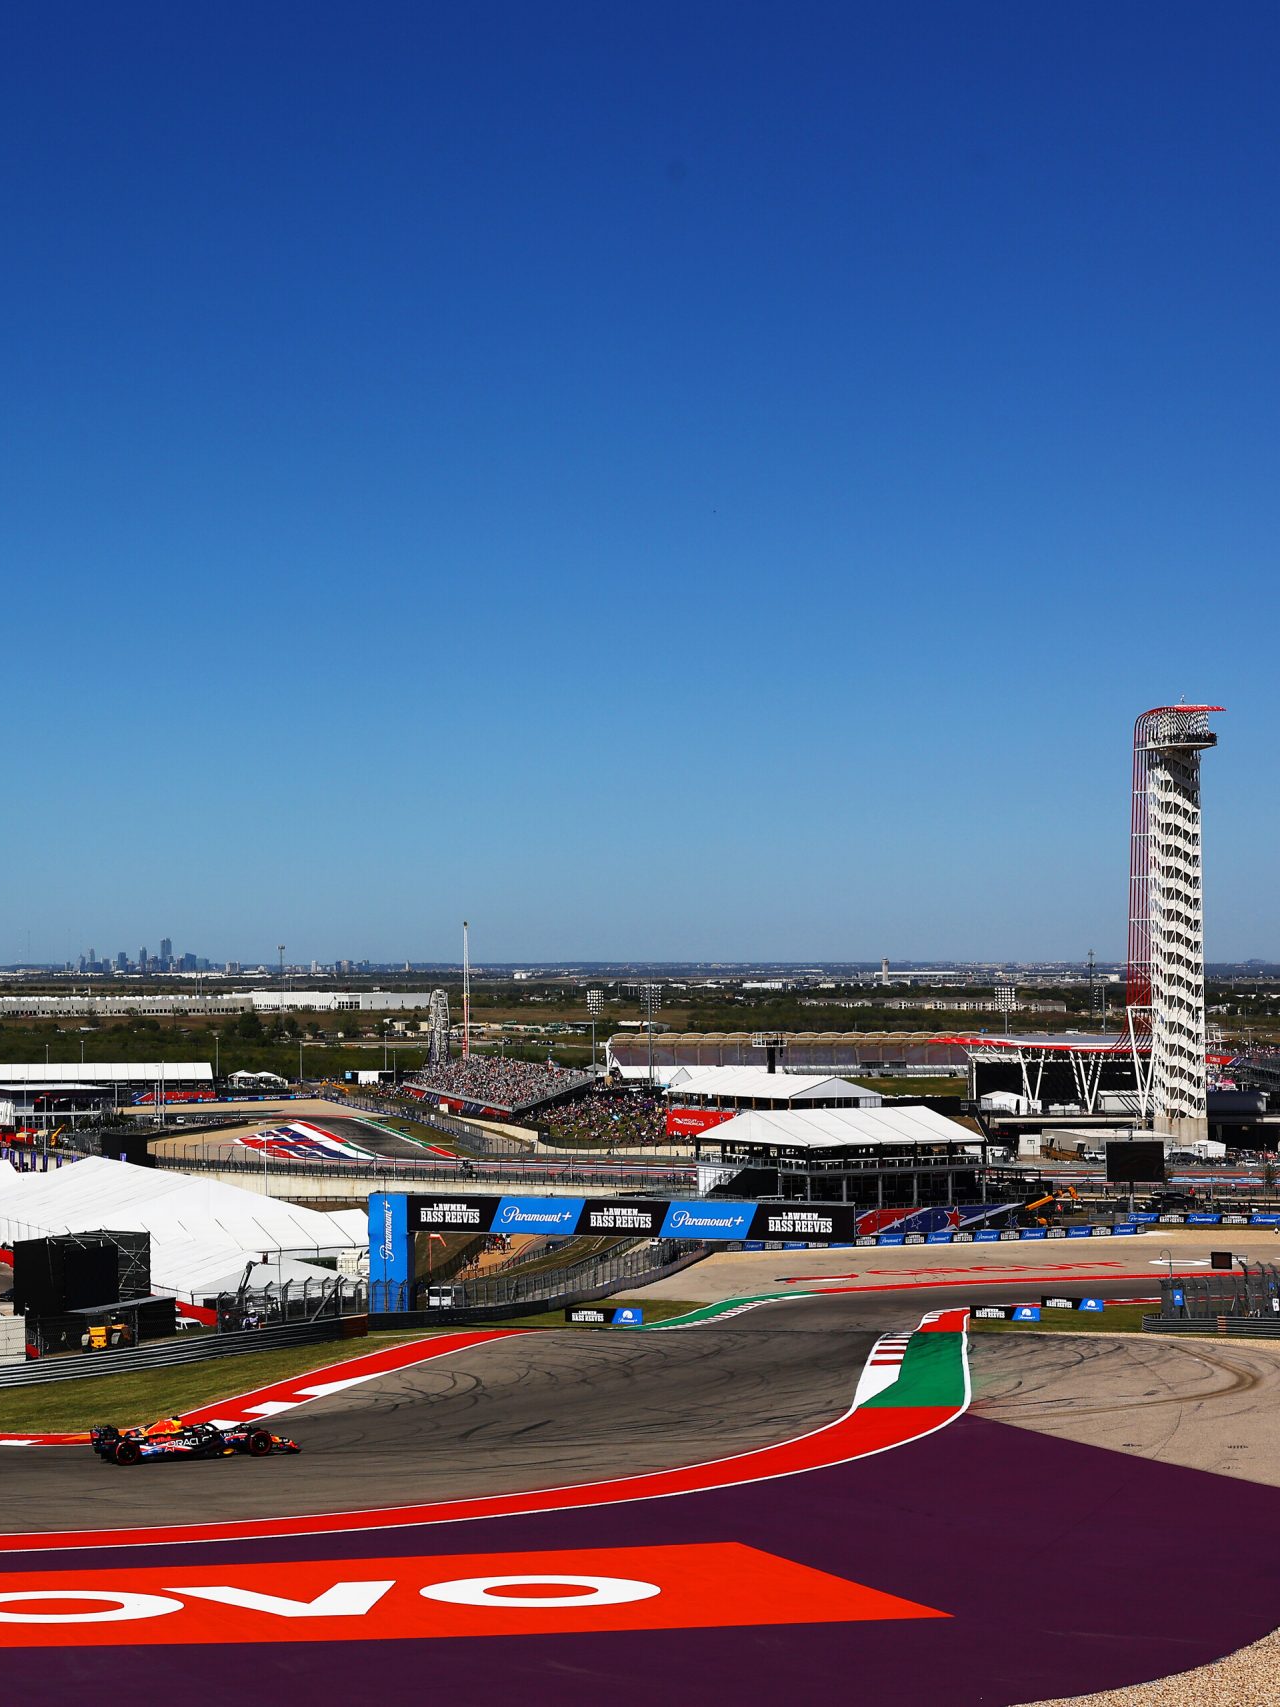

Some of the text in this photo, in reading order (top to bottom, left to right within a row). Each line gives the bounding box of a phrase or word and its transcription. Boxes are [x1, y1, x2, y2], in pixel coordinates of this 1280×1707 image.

[433, 1203, 467, 1211] LAWMEN
[421, 1211, 480, 1223] BASS REEVES
[501, 1206, 572, 1223] Paramount+
[670, 1210, 744, 1228] Paramount+
[590, 1216, 652, 1228] BASS REEVES
[769, 1220, 832, 1232] BASS REEVES
[380, 1200, 394, 1261] Paramount+
[866, 1262, 1126, 1275] CIRCUIT
[167, 1436, 209, 1446] ORACLE
